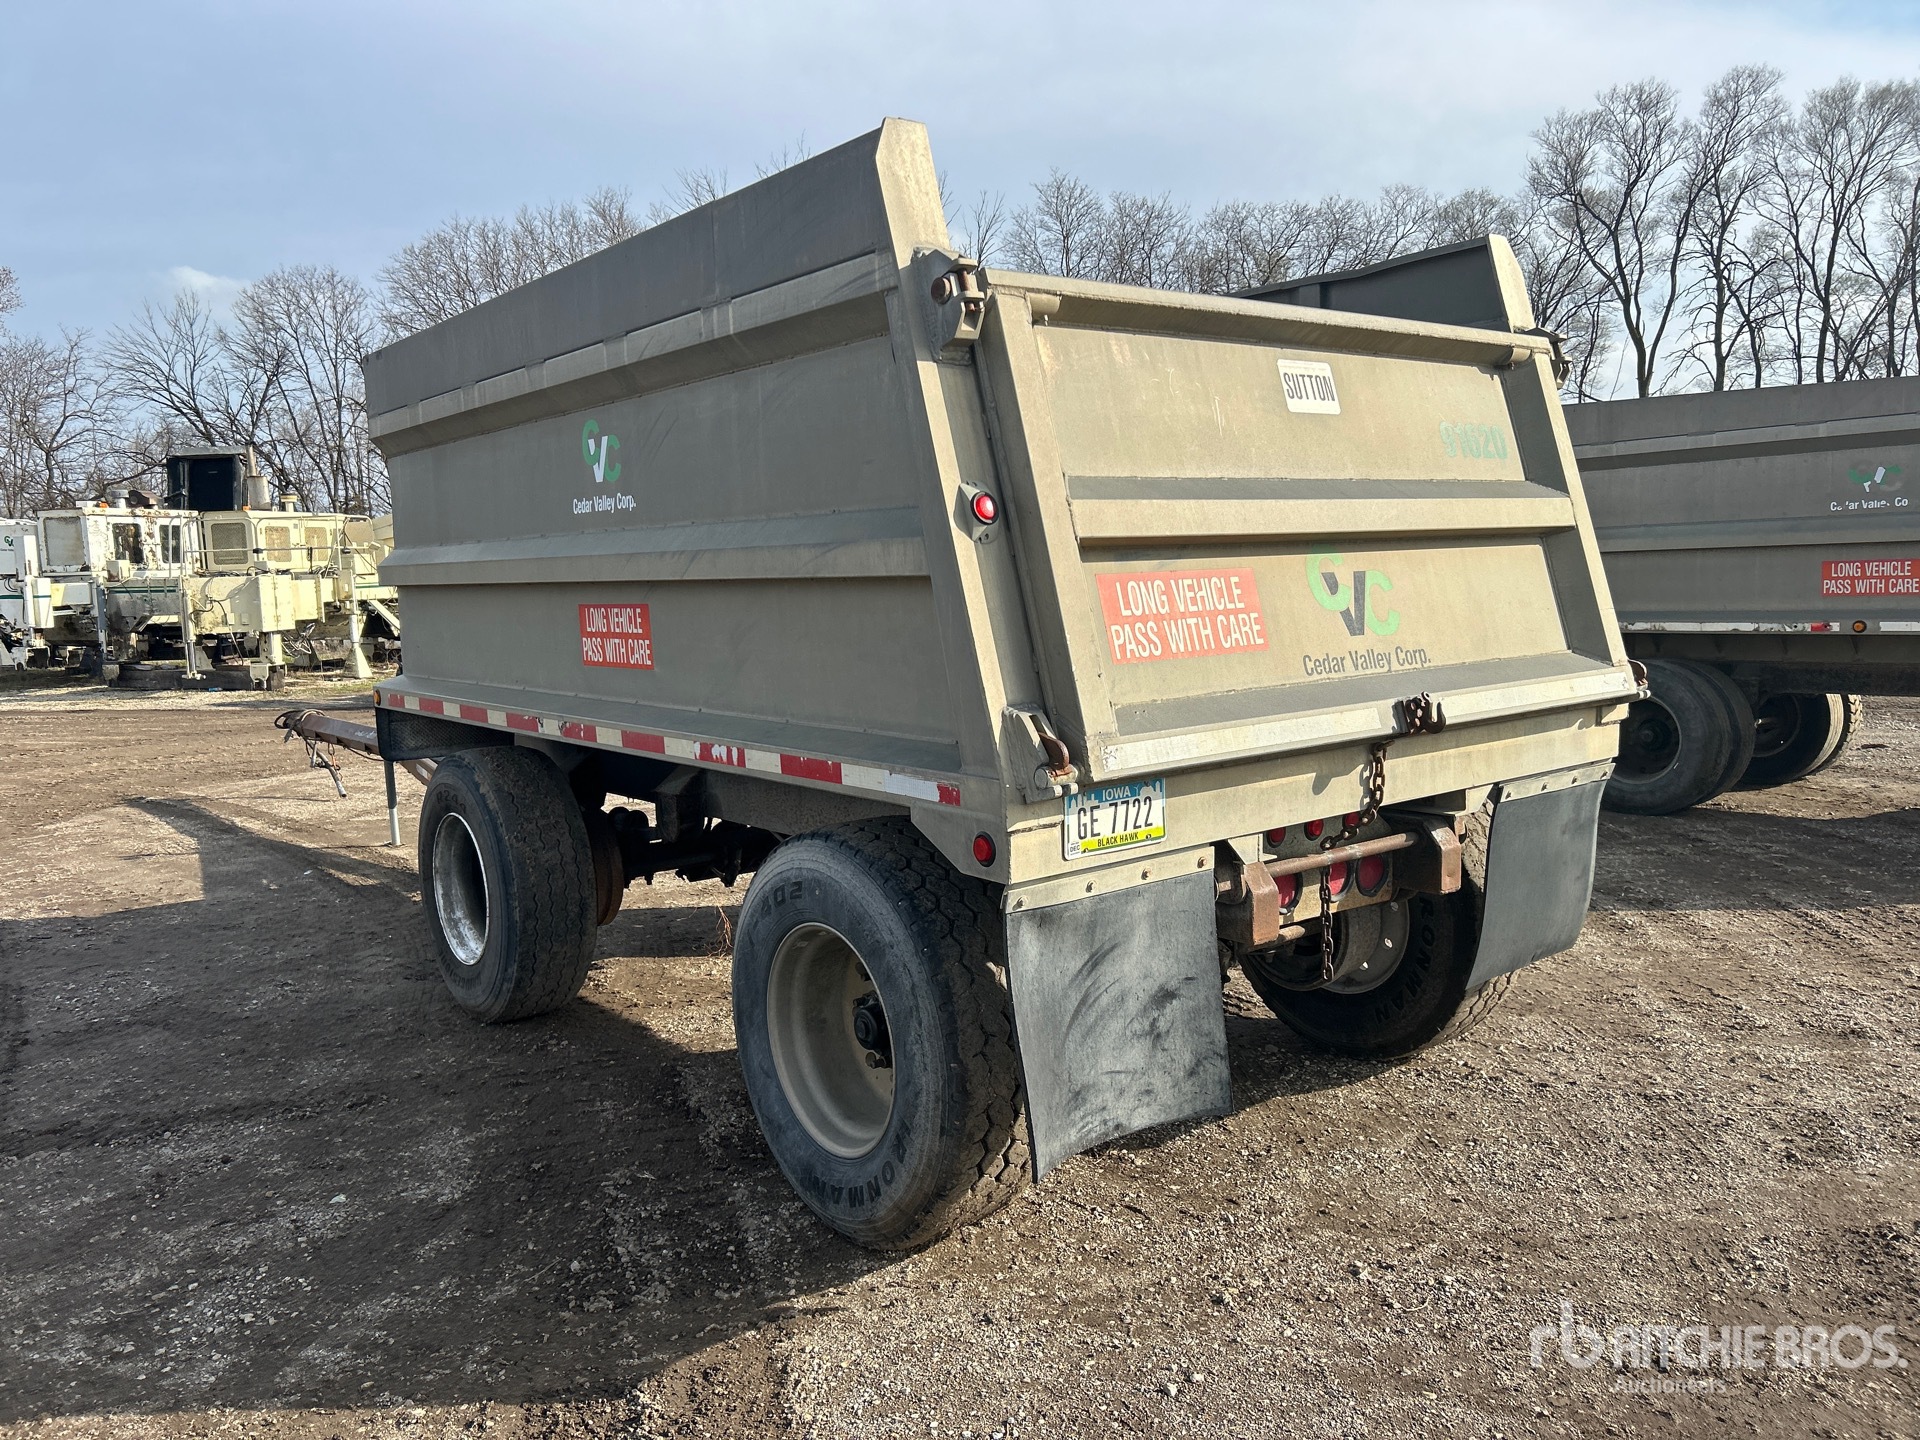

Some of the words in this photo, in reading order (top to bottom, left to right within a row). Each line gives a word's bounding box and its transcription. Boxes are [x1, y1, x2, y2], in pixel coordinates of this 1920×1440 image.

[1283, 372, 1336, 401] SUTTON
[1440, 420, 1508, 460] 91620
[573, 498, 592, 514] Cedar
[593, 495, 615, 513] Valley
[616, 492, 636, 511] Corp.
[1832, 563, 1861, 577] LONG
[1864, 561, 1912, 576] VEHICLE
[1115, 578, 1170, 617] LONG
[1170, 576, 1245, 613] VEHICLE
[1305, 545, 1400, 637] CVC
[1823, 580, 1852, 594] PASS
[1855, 579, 1885, 593] WITH
[1888, 578, 1920, 593] CARE
[585, 608, 607, 632] LONG
[608, 608, 643, 634] VEHICLE
[1110, 621, 1162, 660] PASS
[1163, 617, 1215, 654] WITH
[1216, 612, 1265, 649] CARE
[582, 637, 604, 662] PASS
[604, 638, 628, 663] WITH
[628, 639, 652, 665] CARE
[1302, 655, 1346, 677] Cedar
[1349, 650, 1392, 673] Valley
[1395, 646, 1431, 669] Corp.
[1102, 785, 1131, 801] IOWA
[1077, 804, 1101, 840] GE
[1109, 795, 1153, 834] 7722
[1070, 845, 1080, 853] DEC
[1097, 836, 1118, 847] BLACK
[1119, 831, 1139, 842] HAWK
